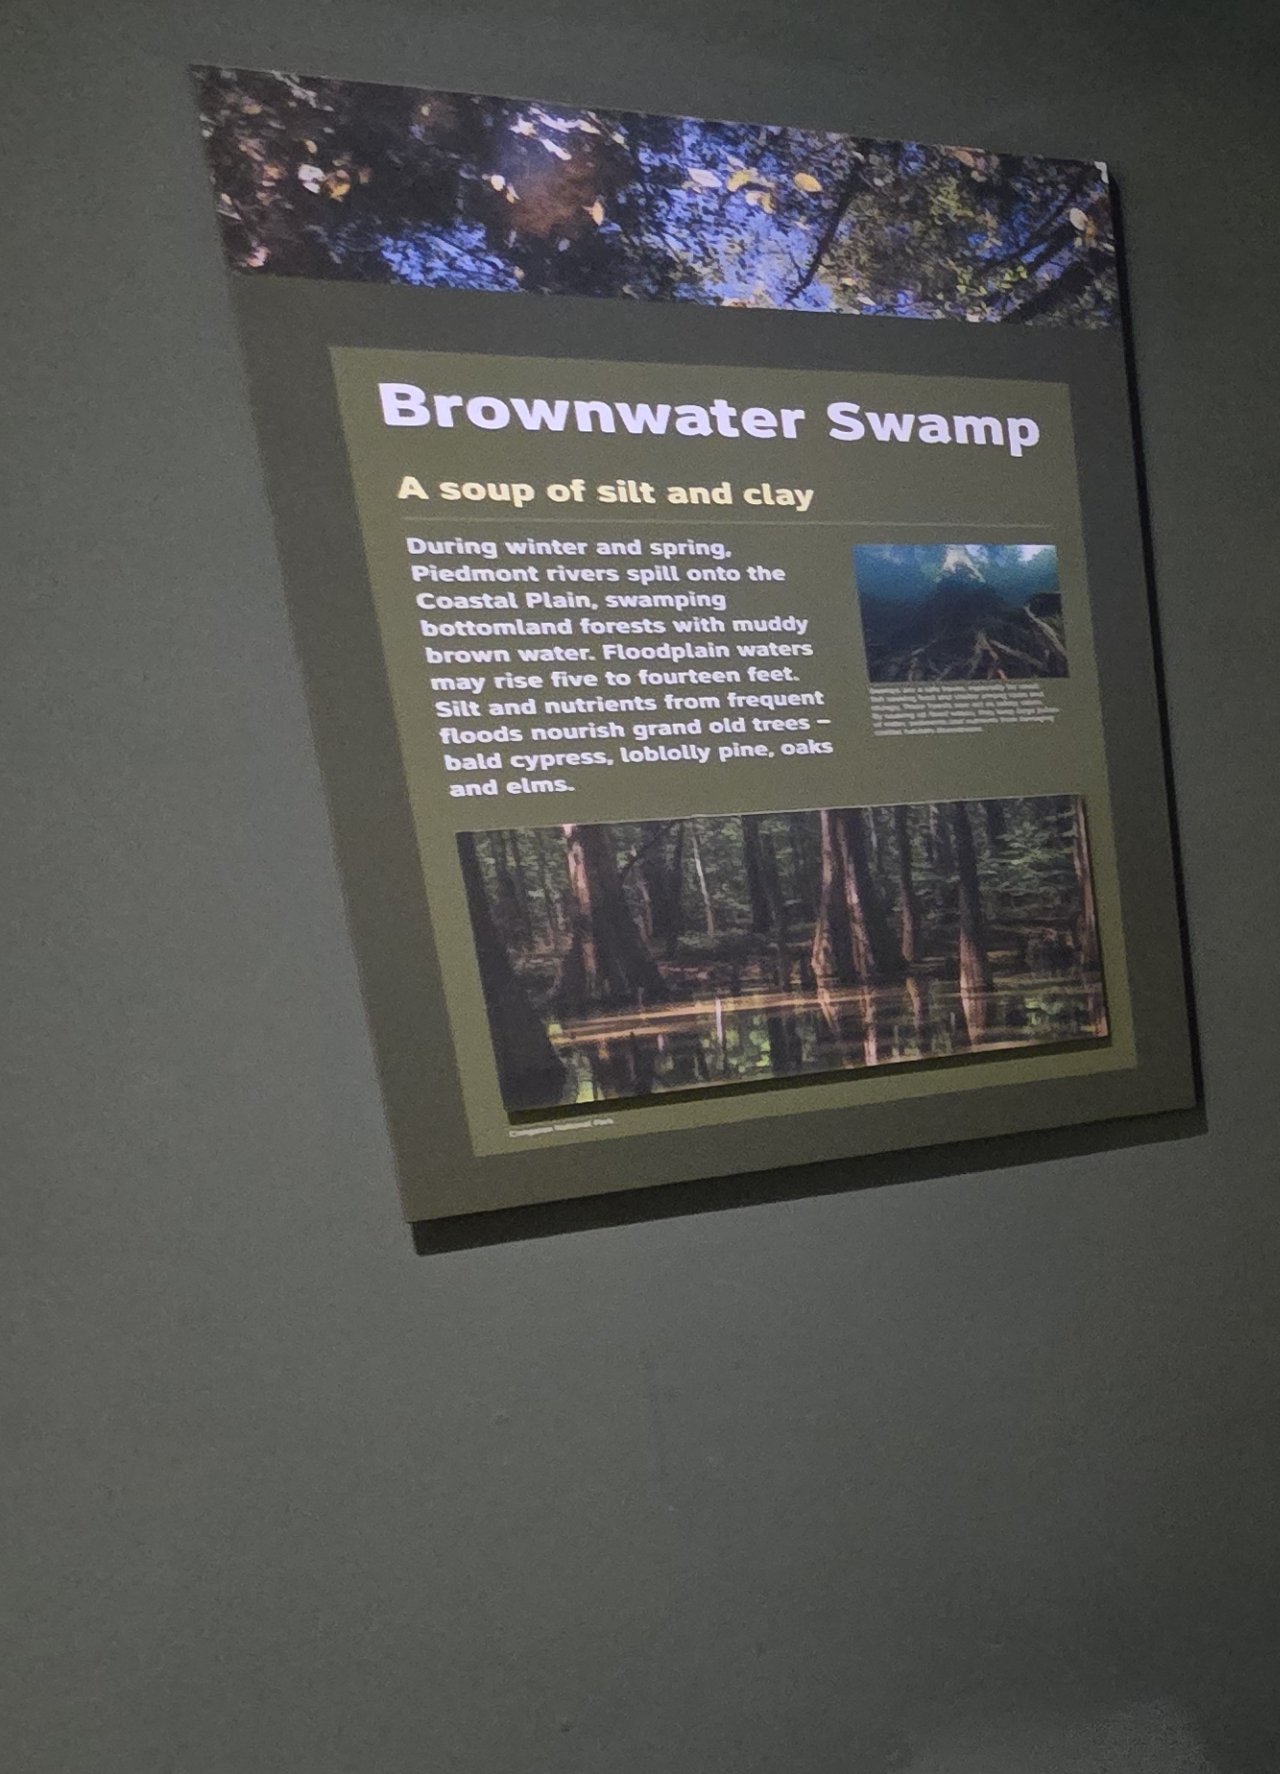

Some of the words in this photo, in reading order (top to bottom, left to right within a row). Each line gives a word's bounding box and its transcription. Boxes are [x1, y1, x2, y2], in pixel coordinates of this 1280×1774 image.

[379, 382, 805, 439] Brownwater
[827, 401, 1040, 457] Swamp
[397, 475, 429, 500] A
[439, 481, 535, 508] soup
[546, 478, 586, 503] of
[597, 479, 656, 504] silt
[667, 481, 733, 505] and
[743, 482, 814, 512] clay
[406, 536, 498, 559] During
[504, 538, 588, 556] winter
[596, 538, 643, 556] and
[649, 539, 732, 560] spring,
[411, 564, 539, 582] Piedmont
[546, 564, 620, 582] rivers
[626, 564, 680, 586] spill
[686, 566, 741, 582] onto
[746, 564, 786, 582] the
[415, 592, 519, 610] Coastal
[525, 591, 598, 610] Plain,
[605, 591, 727, 611] swamping
[420, 618, 573, 637] bottomland
[579, 617, 666, 634] forests
[672, 616, 726, 633] with
[732, 615, 809, 636] muddy
[425, 646, 511, 664] brown
[517, 646, 595, 662] water.
[602, 642, 730, 662] Floodplain
[736, 642, 814, 657] waters
[430, 677, 486, 694] may
[493, 672, 544, 689] rise
[550, 670, 598, 688] five
[604, 671, 632, 686] to
[638, 669, 741, 685] fourteen
[747, 666, 800, 682] feet.
[434, 700, 481, 718] Silt
[488, 698, 537, 716] and
[544, 696, 657, 714] nutrients
[663, 693, 721, 710] from
[727, 690, 824, 710] frequent
[439, 725, 524, 745] floods
[530, 722, 626, 741] nourish
[632, 718, 702, 741] grand
[708, 716, 747, 734] old
[751, 717, 811, 732] trees
[443, 752, 503, 771] bald
[510, 751, 614, 772] cypress,
[619, 744, 711, 764] loblolly
[718, 742, 775, 763] pine,
[780, 738, 834, 756] oaks
[449, 778, 499, 798] and
[506, 777, 575, 794] elms.
